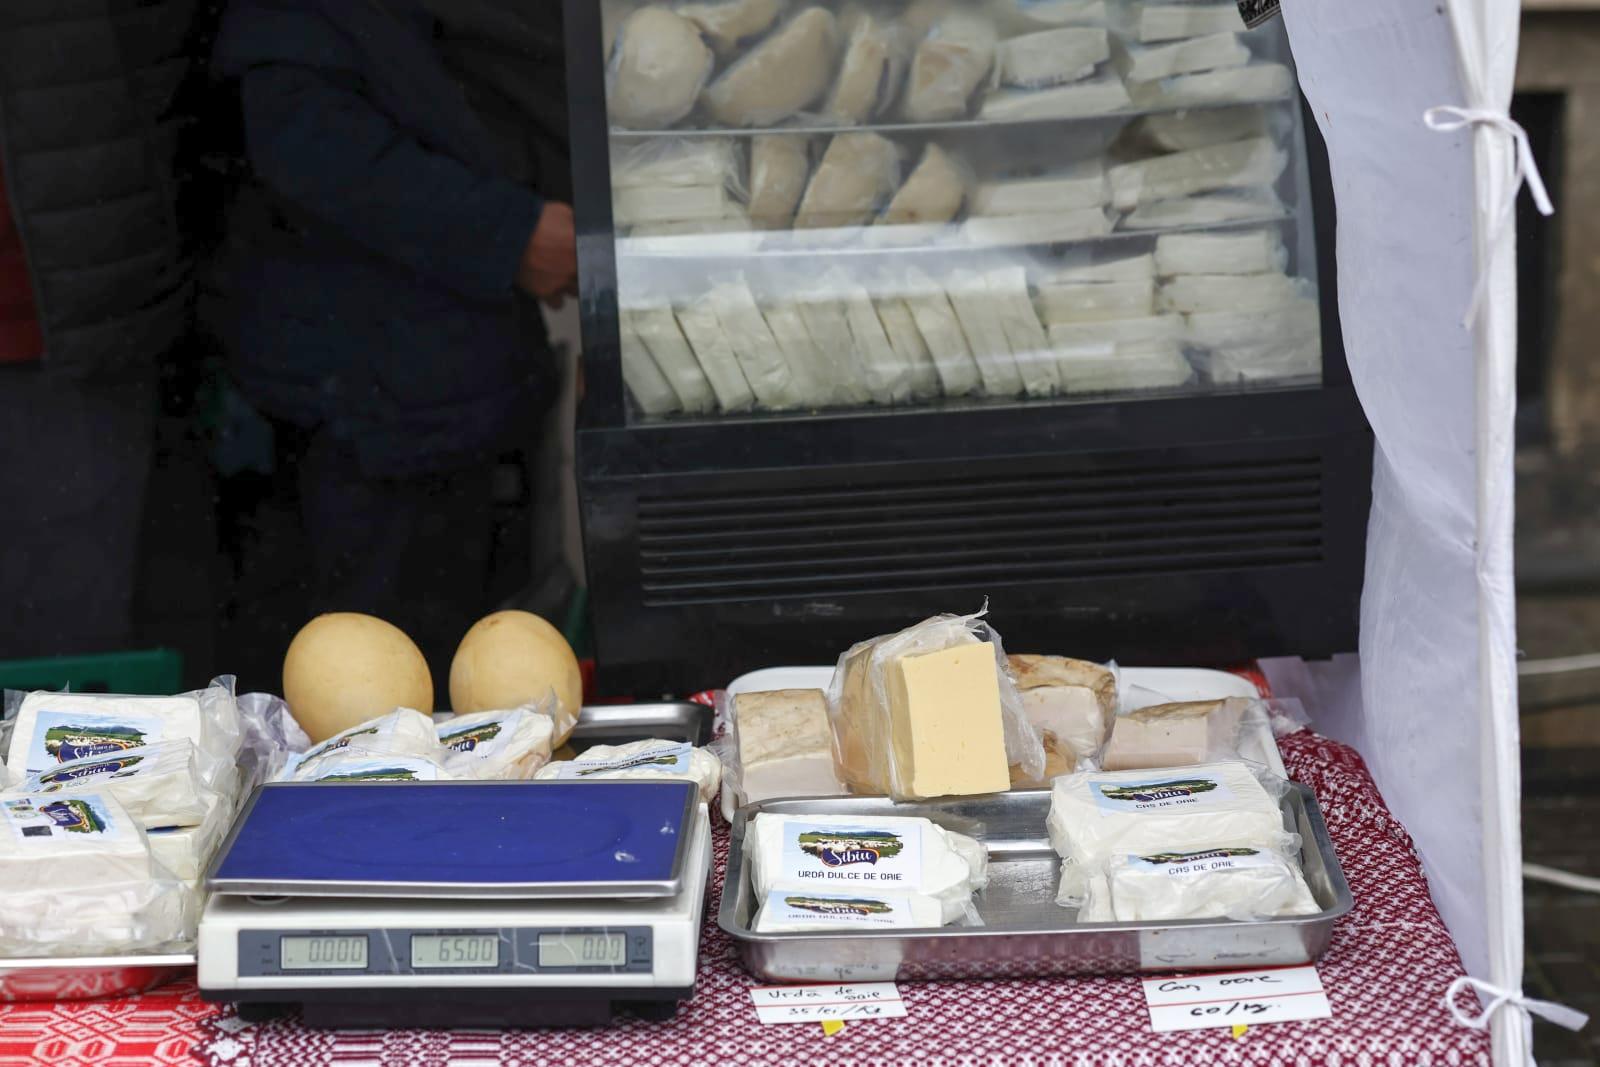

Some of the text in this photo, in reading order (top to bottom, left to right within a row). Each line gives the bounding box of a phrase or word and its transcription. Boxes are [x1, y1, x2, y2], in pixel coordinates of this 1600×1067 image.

[828, 850, 872, 866] Sibiu
[1193, 864, 1208, 872] DE
[1211, 861, 1235, 870] OAIE
[827, 871, 860, 880] DULCE
[863, 872, 877, 880] DE
[880, 873, 903, 881] OAIE
